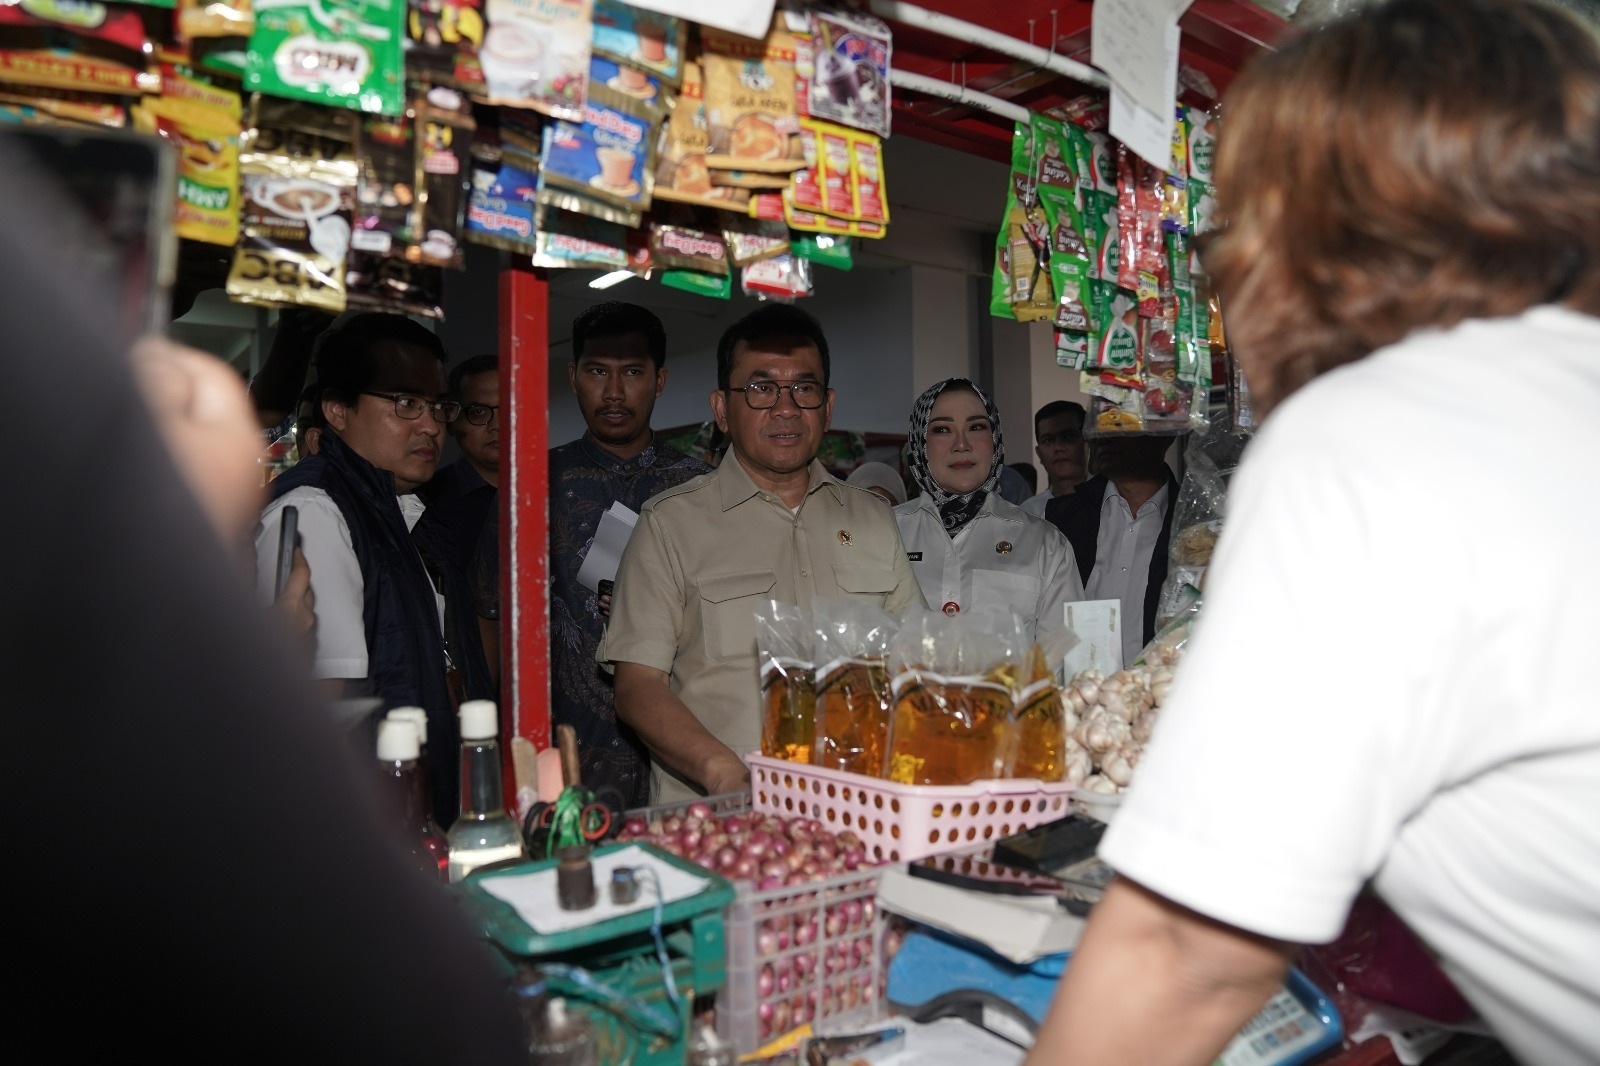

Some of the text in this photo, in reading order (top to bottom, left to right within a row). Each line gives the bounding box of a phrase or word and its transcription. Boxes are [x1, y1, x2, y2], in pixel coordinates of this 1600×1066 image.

[291, 49, 358, 72] MIO
[496, 212, 531, 237] Good
[663, 232, 723, 259] Good Day
[241, 253, 336, 290] ABC
